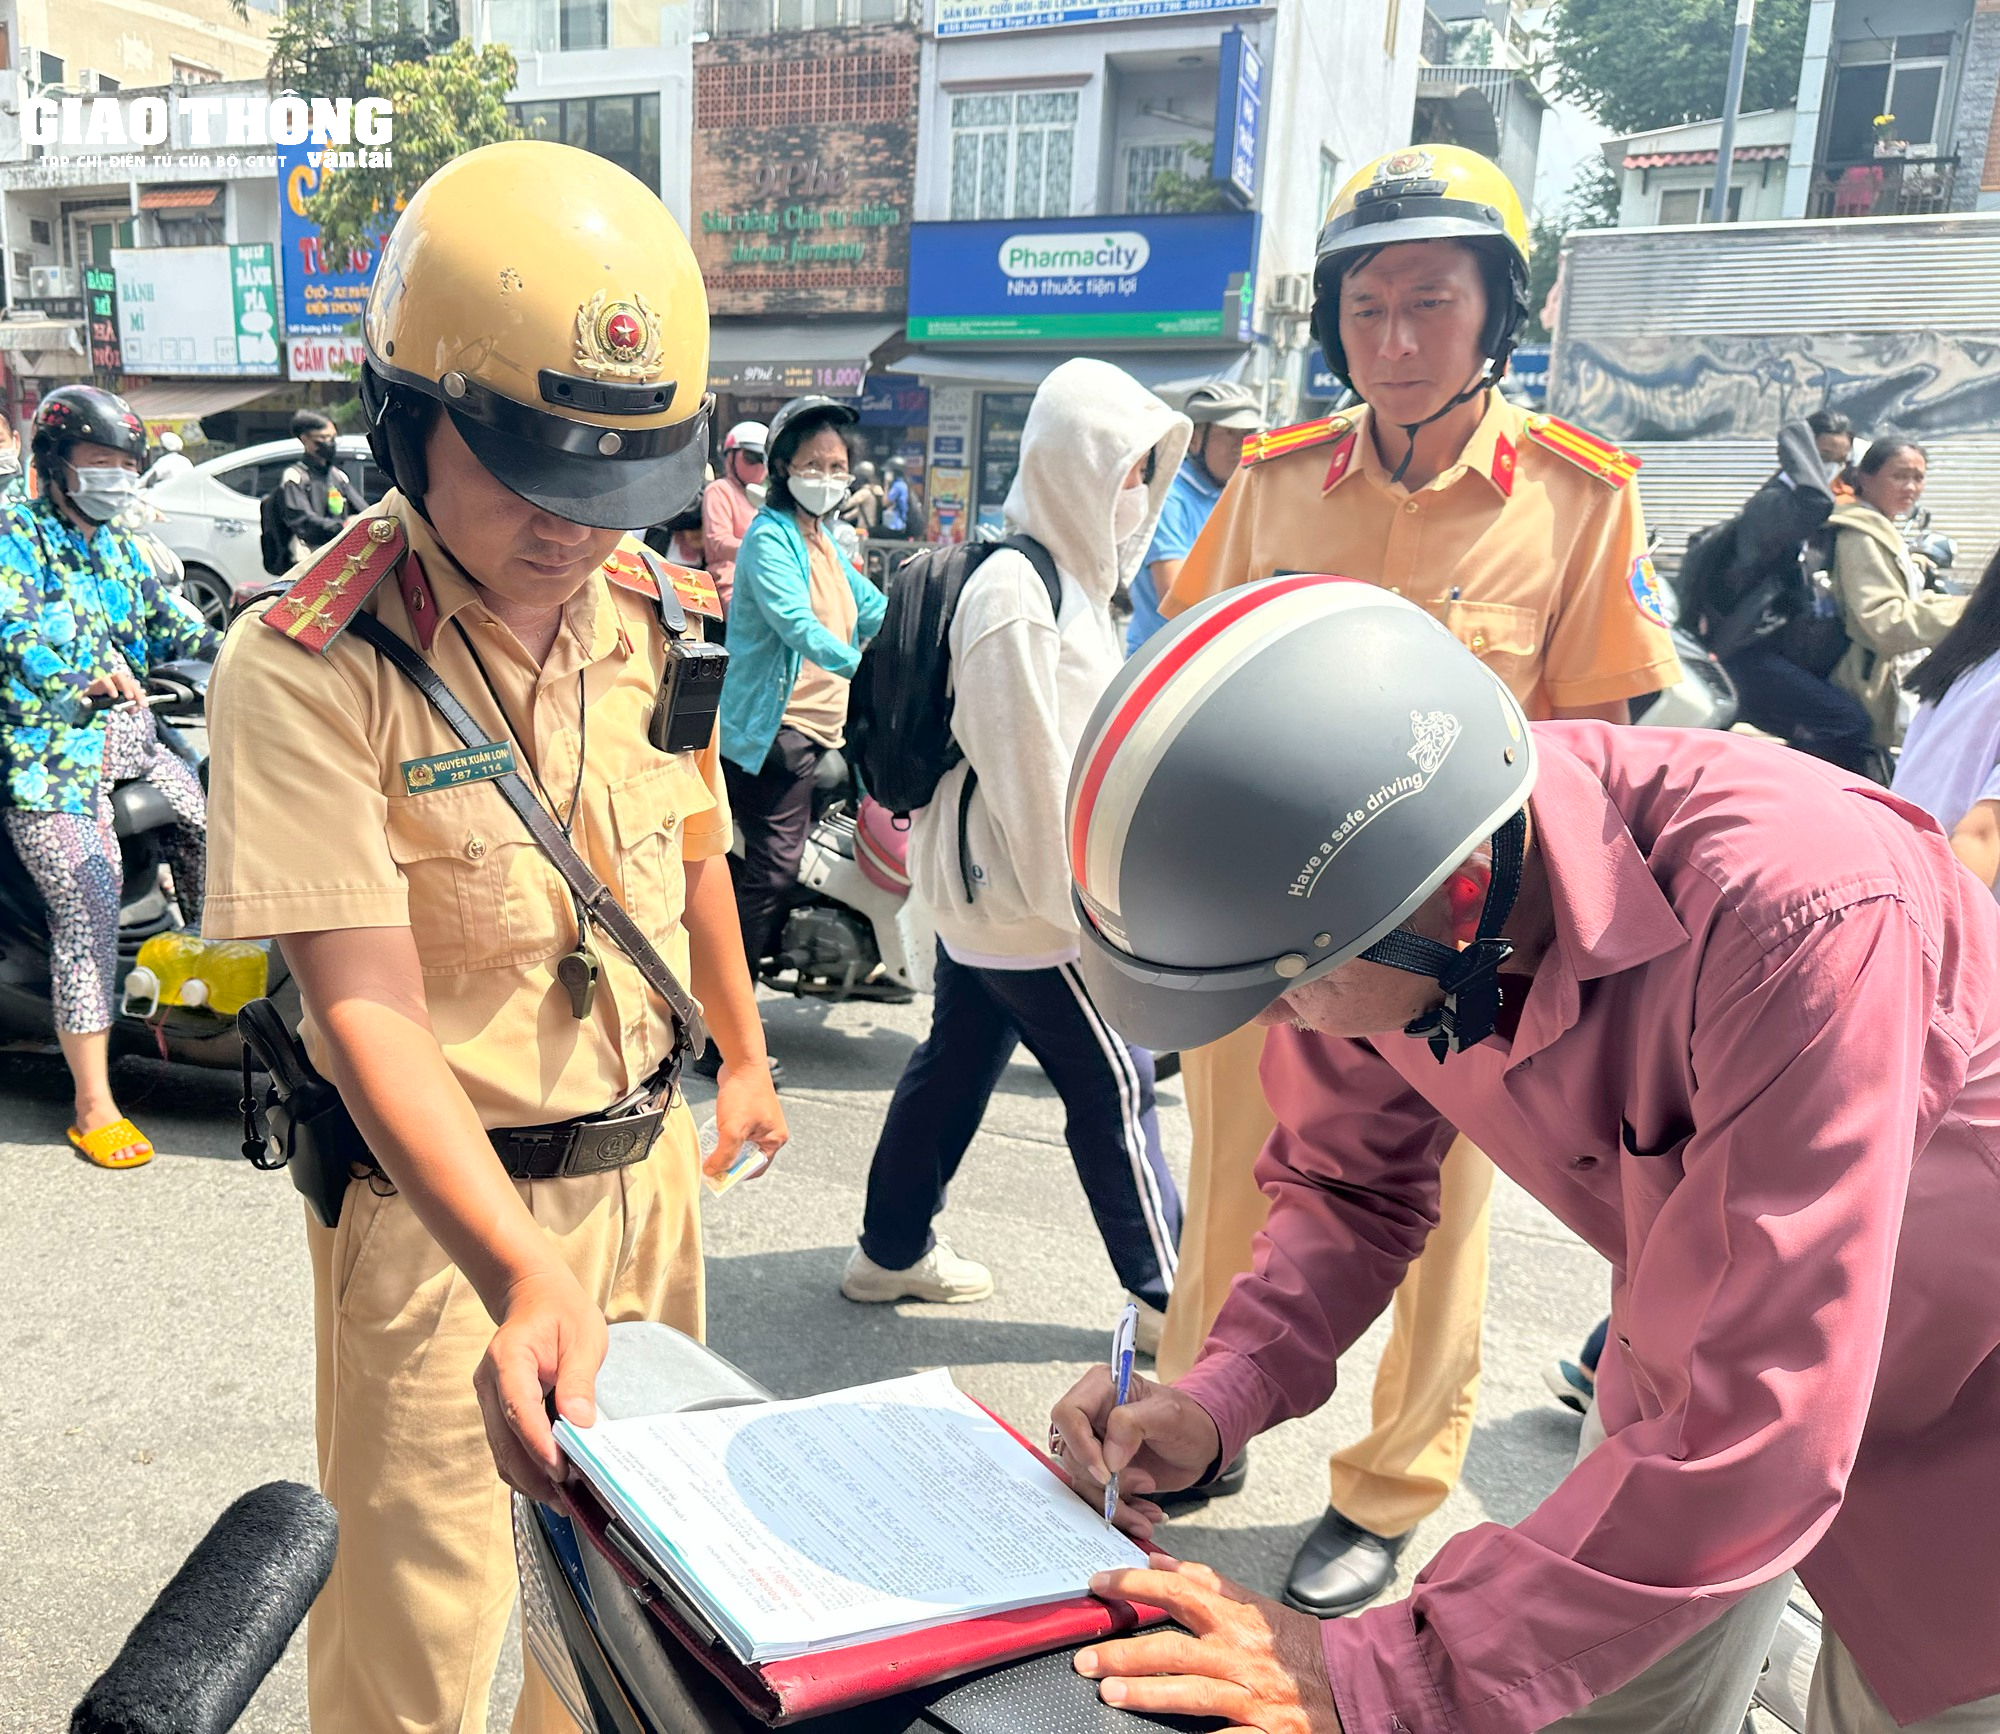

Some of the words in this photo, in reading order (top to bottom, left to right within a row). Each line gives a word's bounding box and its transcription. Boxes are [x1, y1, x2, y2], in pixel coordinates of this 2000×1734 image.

[1008, 238, 1138, 270] Pharmacity
[87, 267, 115, 292] BÁNH
[122, 277, 155, 302] BÁNH
[1007, 279, 1038, 296] Nhà
[1041, 277, 1083, 296] thuốc
[1086, 277, 1116, 297] tiện
[1118, 276, 1138, 297] lợi
[293, 336, 325, 373] CẦM
[468, 751, 491, 765] XUÂN
[450, 769, 472, 782] 287
[482, 763, 503, 775] 114
[1287, 854, 1322, 897] Have
[1319, 841, 1334, 854] a
[1331, 808, 1366, 842] safe
[1366, 772, 1423, 811] driving
